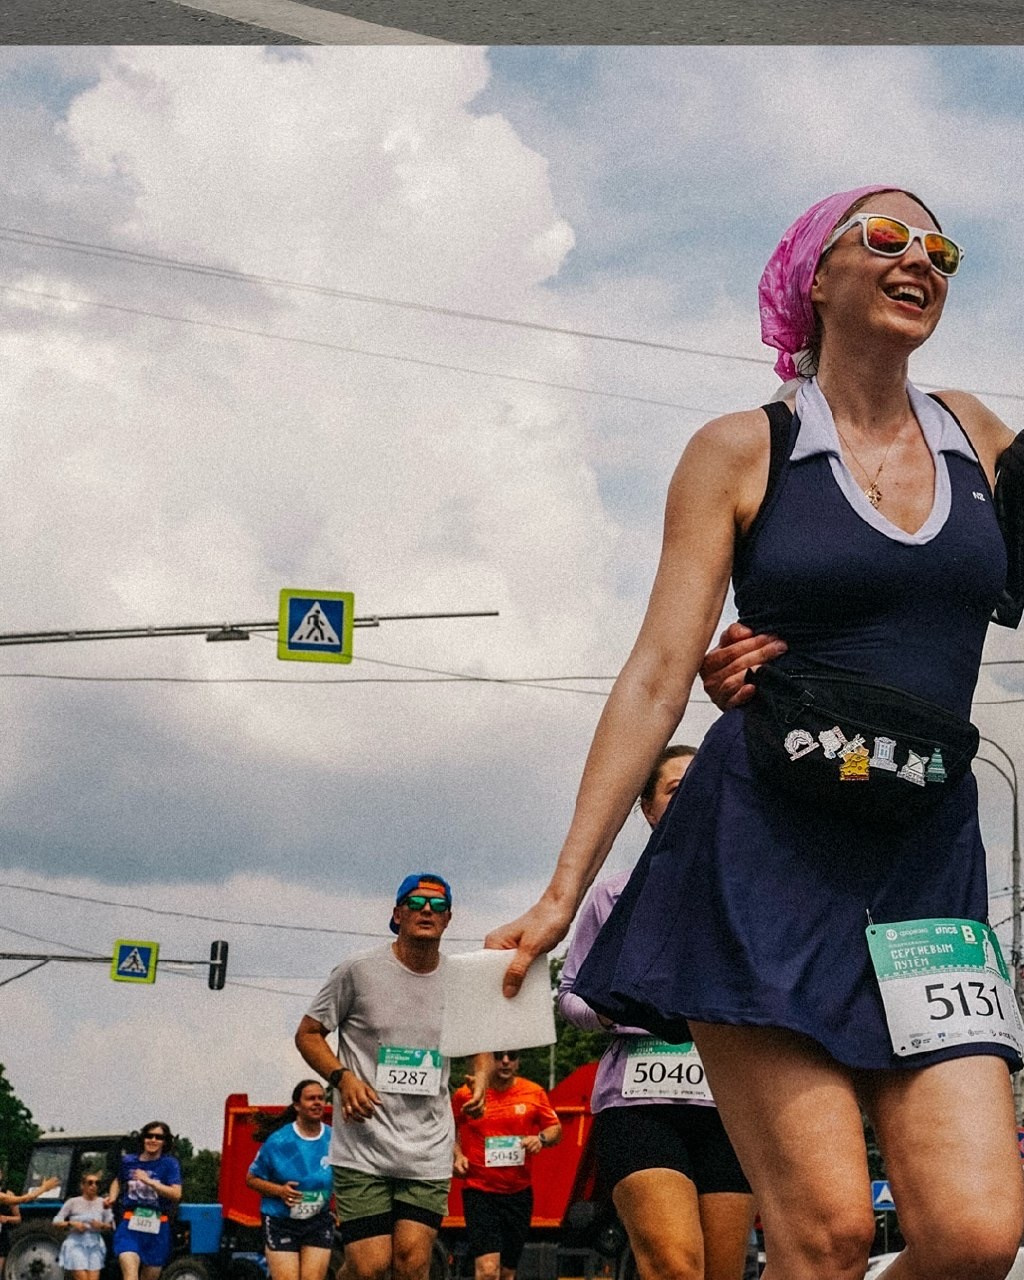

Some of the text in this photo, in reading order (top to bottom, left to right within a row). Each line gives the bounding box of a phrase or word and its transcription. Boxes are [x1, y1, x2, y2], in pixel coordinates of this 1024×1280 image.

[924, 981, 1005, 1021] 5131
[387, 1069, 428, 1086] 5287
[633, 1061, 704, 1085] 5040
